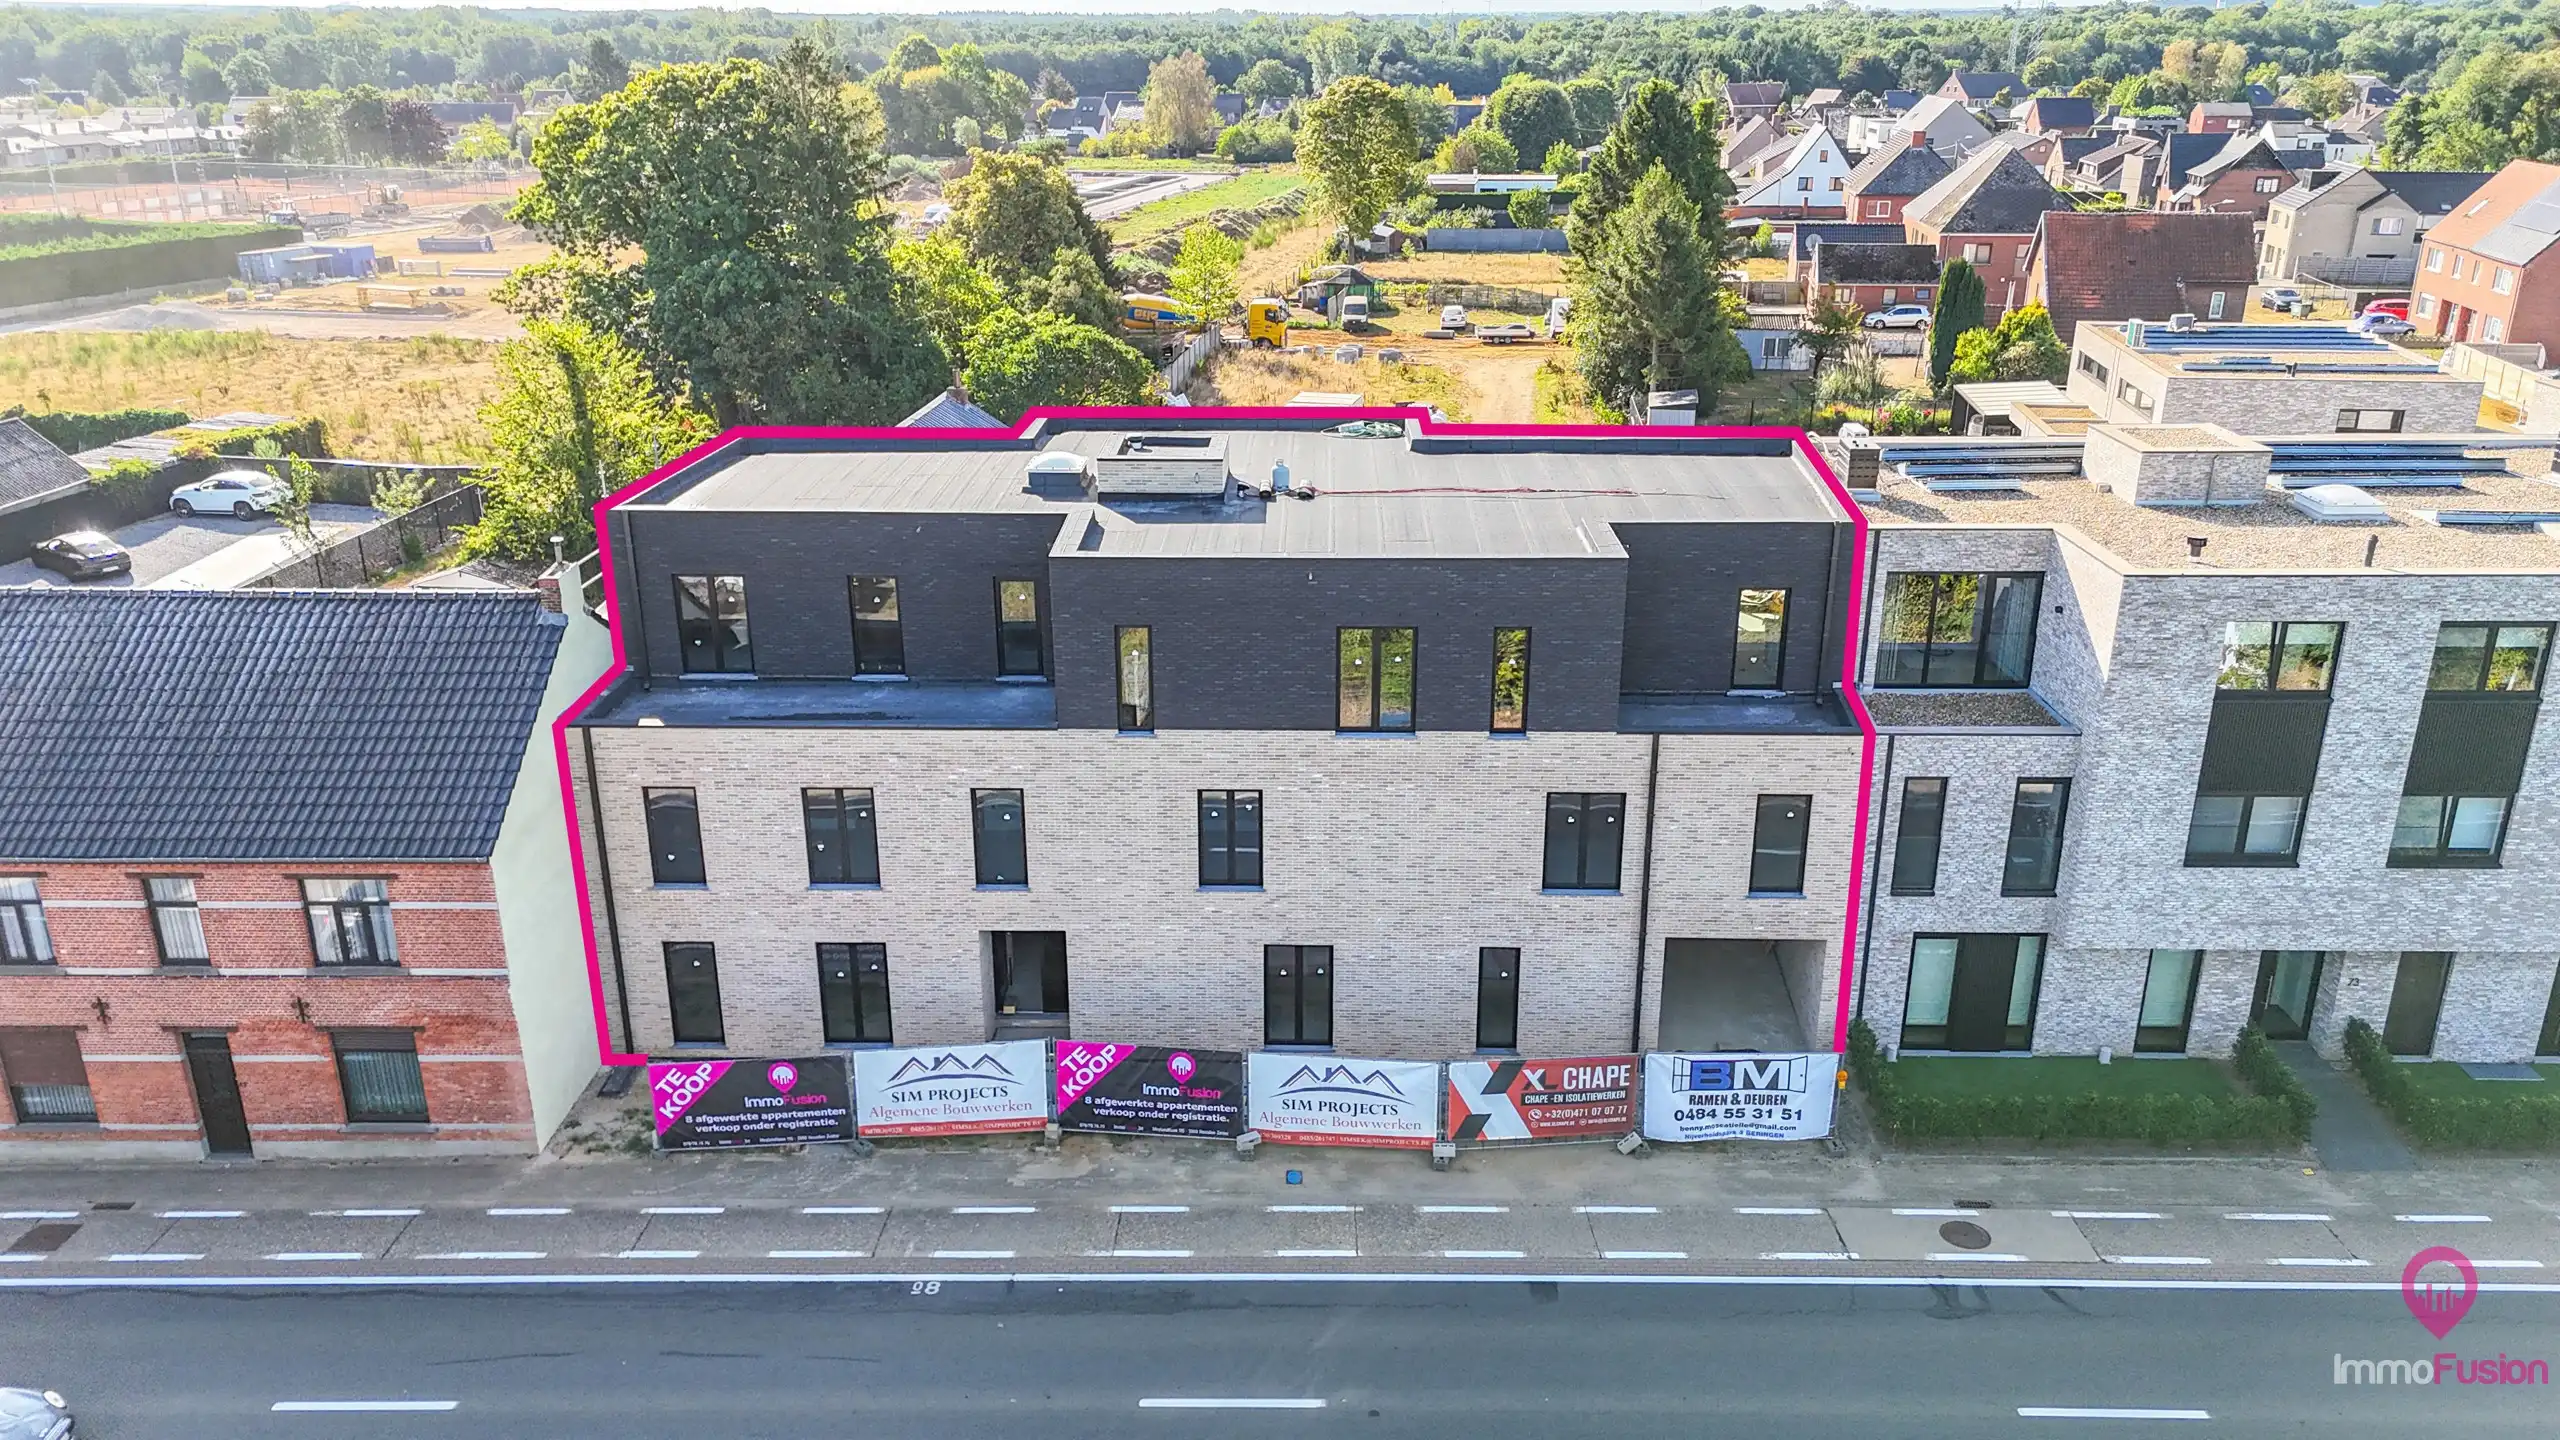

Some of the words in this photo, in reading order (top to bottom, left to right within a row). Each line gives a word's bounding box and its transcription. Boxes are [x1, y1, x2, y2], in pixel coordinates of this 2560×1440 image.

[1060, 1046, 1092, 1072] TE
[1062, 1044, 1116, 1098] KOOP
[1522, 1069, 1559, 1091] XL
[1564, 1064, 1631, 1090] CHAPE
[654, 1068, 688, 1094] TE
[659, 1062, 713, 1118] KOOP
[892, 1091, 922, 1103] SIM
[928, 1086, 1008, 1102] PROJECTS
[1142, 1083, 1223, 1099] ImmoFusion
[1524, 1094, 1548, 1104] CHAPE
[1566, 1090, 1626, 1102] ISOLATIEWERKEN
[744, 1093, 827, 1108] ImmoFusion
[1084, 1096, 1092, 1104] 8
[1094, 1098, 1154, 1108] afgewerkte
[1156, 1101, 1238, 1112] appartementen
[1282, 1099, 1312, 1111] SIM
[1318, 1101, 1398, 1116] PROJECTS
[1689, 1094, 1728, 1106] RAMEN
[1730, 1093, 1742, 1106] &
[1744, 1094, 1788, 1106] DEUREN
[685, 1116, 693, 1124] 8
[696, 1113, 759, 1124] afgewerkte
[762, 1108, 846, 1121] appartementen
[869, 1105, 938, 1121] Algemene
[944, 1100, 1032, 1114] Bouwwerken
[1093, 1107, 1136, 1118] verkoop
[1138, 1110, 1170, 1120] onder
[1172, 1112, 1230, 1122] registratie.
[1544, 1108, 1588, 1120] +32(0)471
[1592, 1107, 1602, 1116] 07
[1604, 1106, 1614, 1116] 07
[1618, 1105, 1628, 1114] 77
[1674, 1108, 1718, 1121] 0484
[1723, 1108, 1746, 1118] 55
[1752, 1108, 1773, 1118] 31
[1781, 1108, 1802, 1120] 51
[695, 1123, 741, 1134] verkoop
[743, 1121, 776, 1132] onder
[778, 1118, 838, 1130] registratie.
[1260, 1112, 1327, 1128] Algemene
[1332, 1116, 1422, 1130] Bouwwerken
